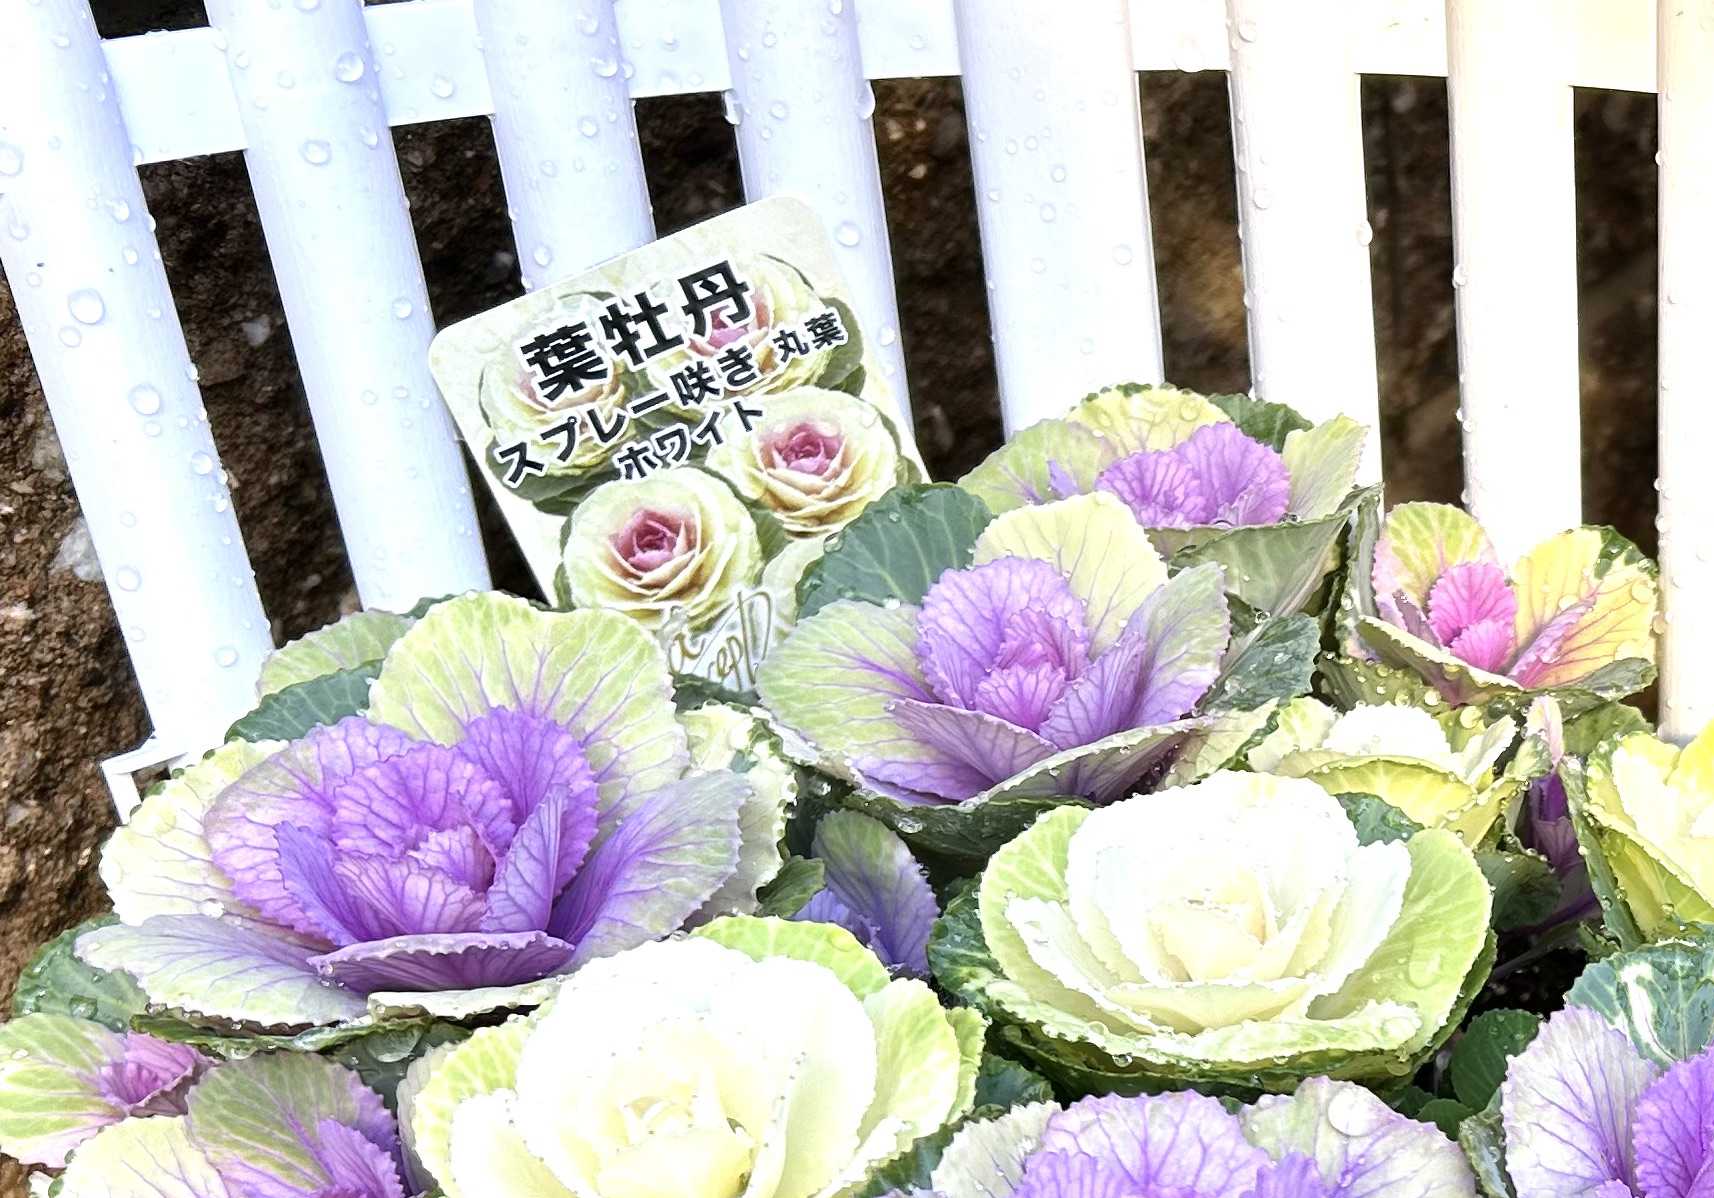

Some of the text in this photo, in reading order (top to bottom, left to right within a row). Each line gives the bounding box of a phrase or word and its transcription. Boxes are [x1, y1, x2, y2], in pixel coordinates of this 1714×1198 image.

[498, 312, 845, 484] スプレー咲き 丸葉
[519, 259, 751, 402] 葉牡丹
[616, 401, 763, 480] ホワイト
